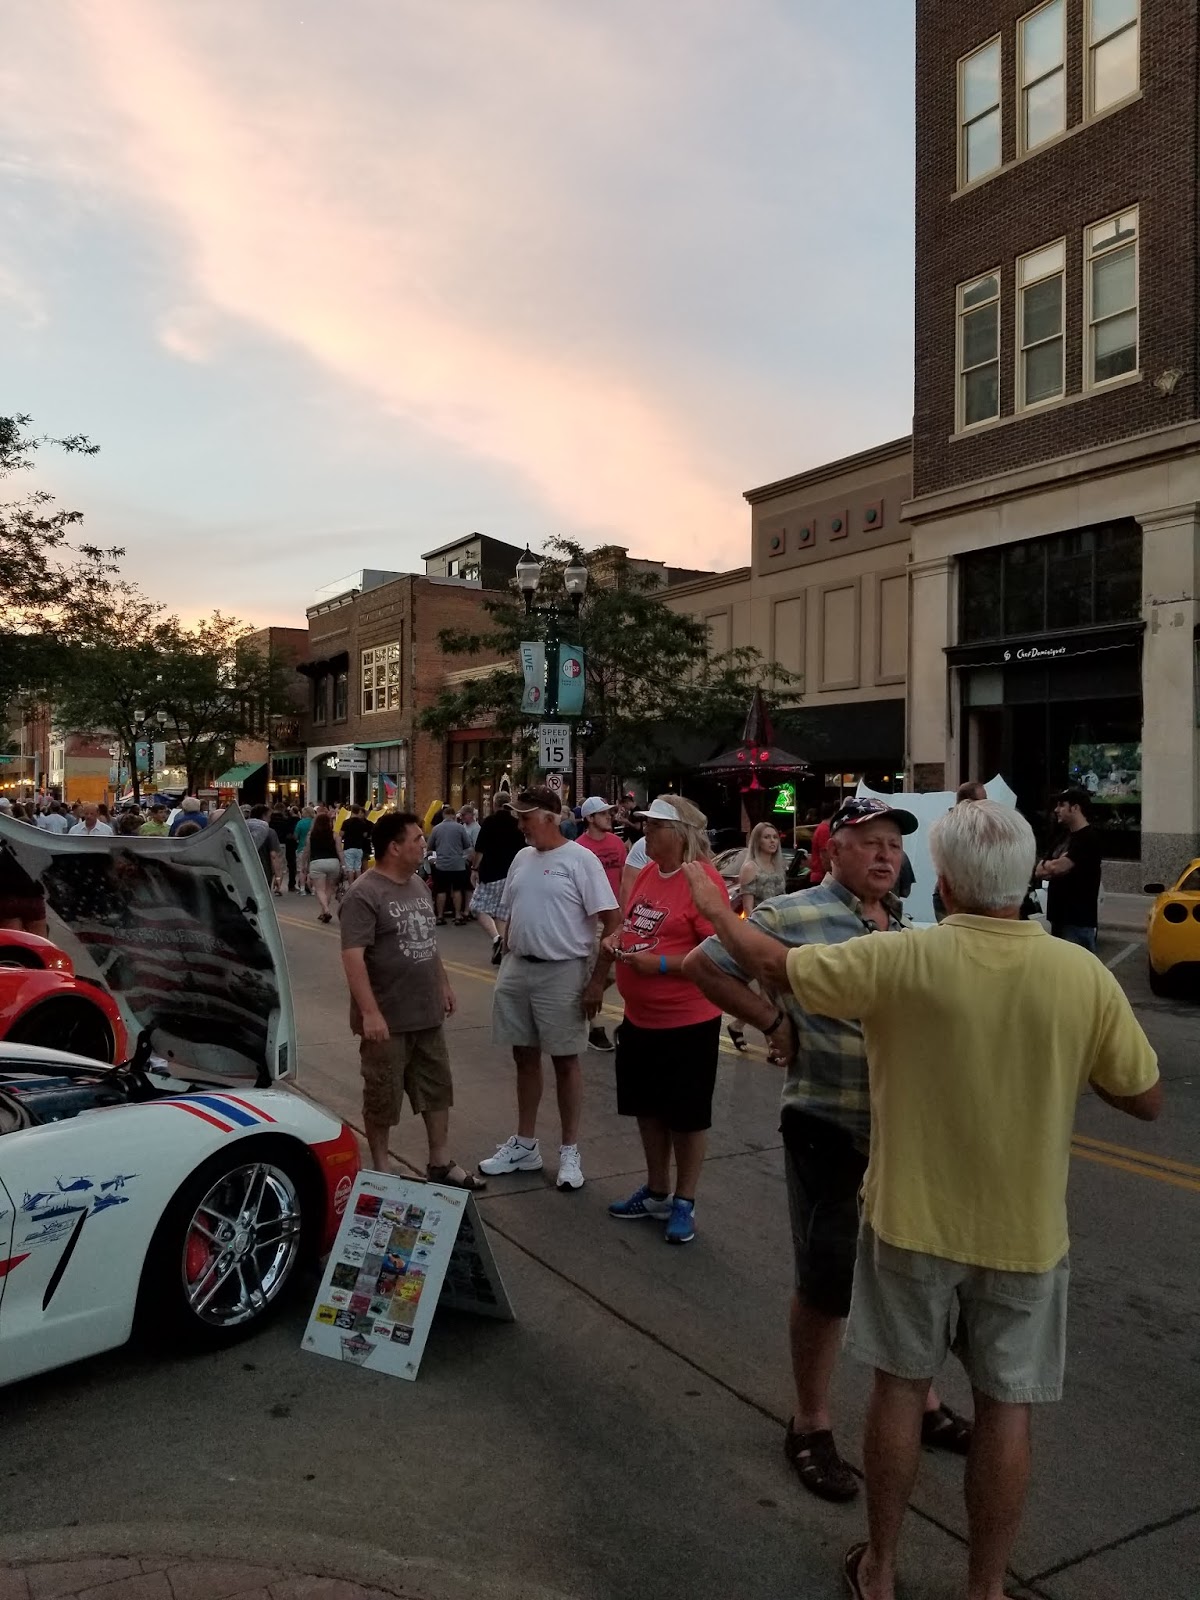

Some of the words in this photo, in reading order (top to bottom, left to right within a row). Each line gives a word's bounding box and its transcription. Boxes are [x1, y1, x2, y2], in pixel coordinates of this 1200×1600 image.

[523, 648, 534, 673] LIVE
[564, 665, 580, 673] DTSF
[542, 728, 568, 736] SPEED
[544, 737, 565, 745] LIMIT
[545, 746, 564, 763] 15
[396, 919, 408, 936] 17
